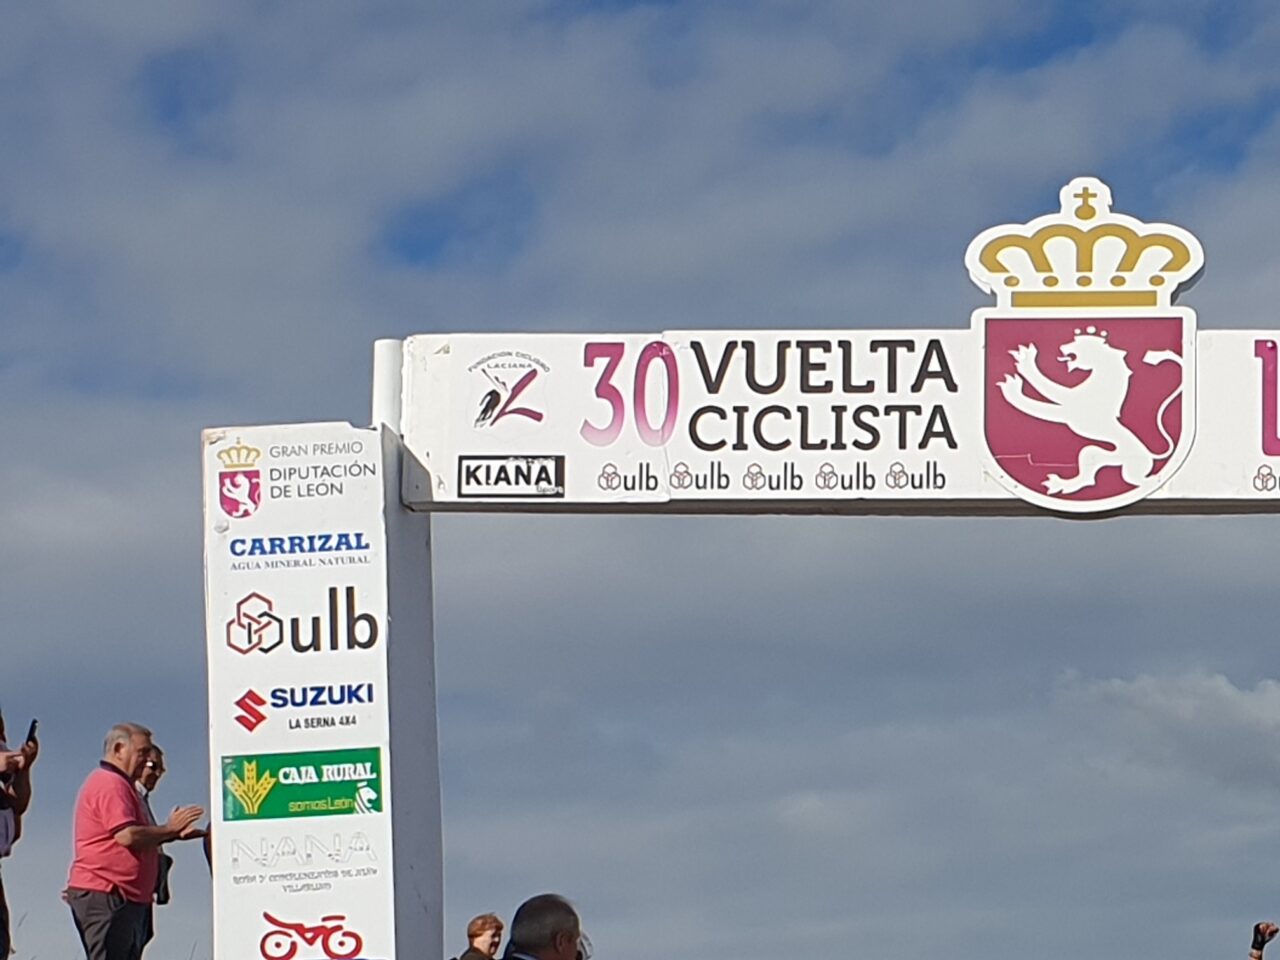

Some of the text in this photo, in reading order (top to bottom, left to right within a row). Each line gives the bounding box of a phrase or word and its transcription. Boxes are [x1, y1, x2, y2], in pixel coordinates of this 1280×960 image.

[580, 340, 959, 447] 30 VUELTA
[688, 404, 959, 451] CICLISTA
[269, 441, 364, 459] GRAN PREMIO
[269, 460, 377, 481] DIPUTACIÓN
[465, 464, 553, 486] KIANA
[270, 479, 344, 499] DE LEÓN
[229, 533, 371, 556] CARRIZAL
[230, 555, 371, 571] AGUA MINERAL NATURAL
[290, 586, 379, 653] ulb
[270, 683, 375, 709] SUZUKI
[289, 714, 357, 730] LA SERNA 4X4
[278, 762, 377, 785] CAJA RURAL
[231, 831, 379, 869] NANA
